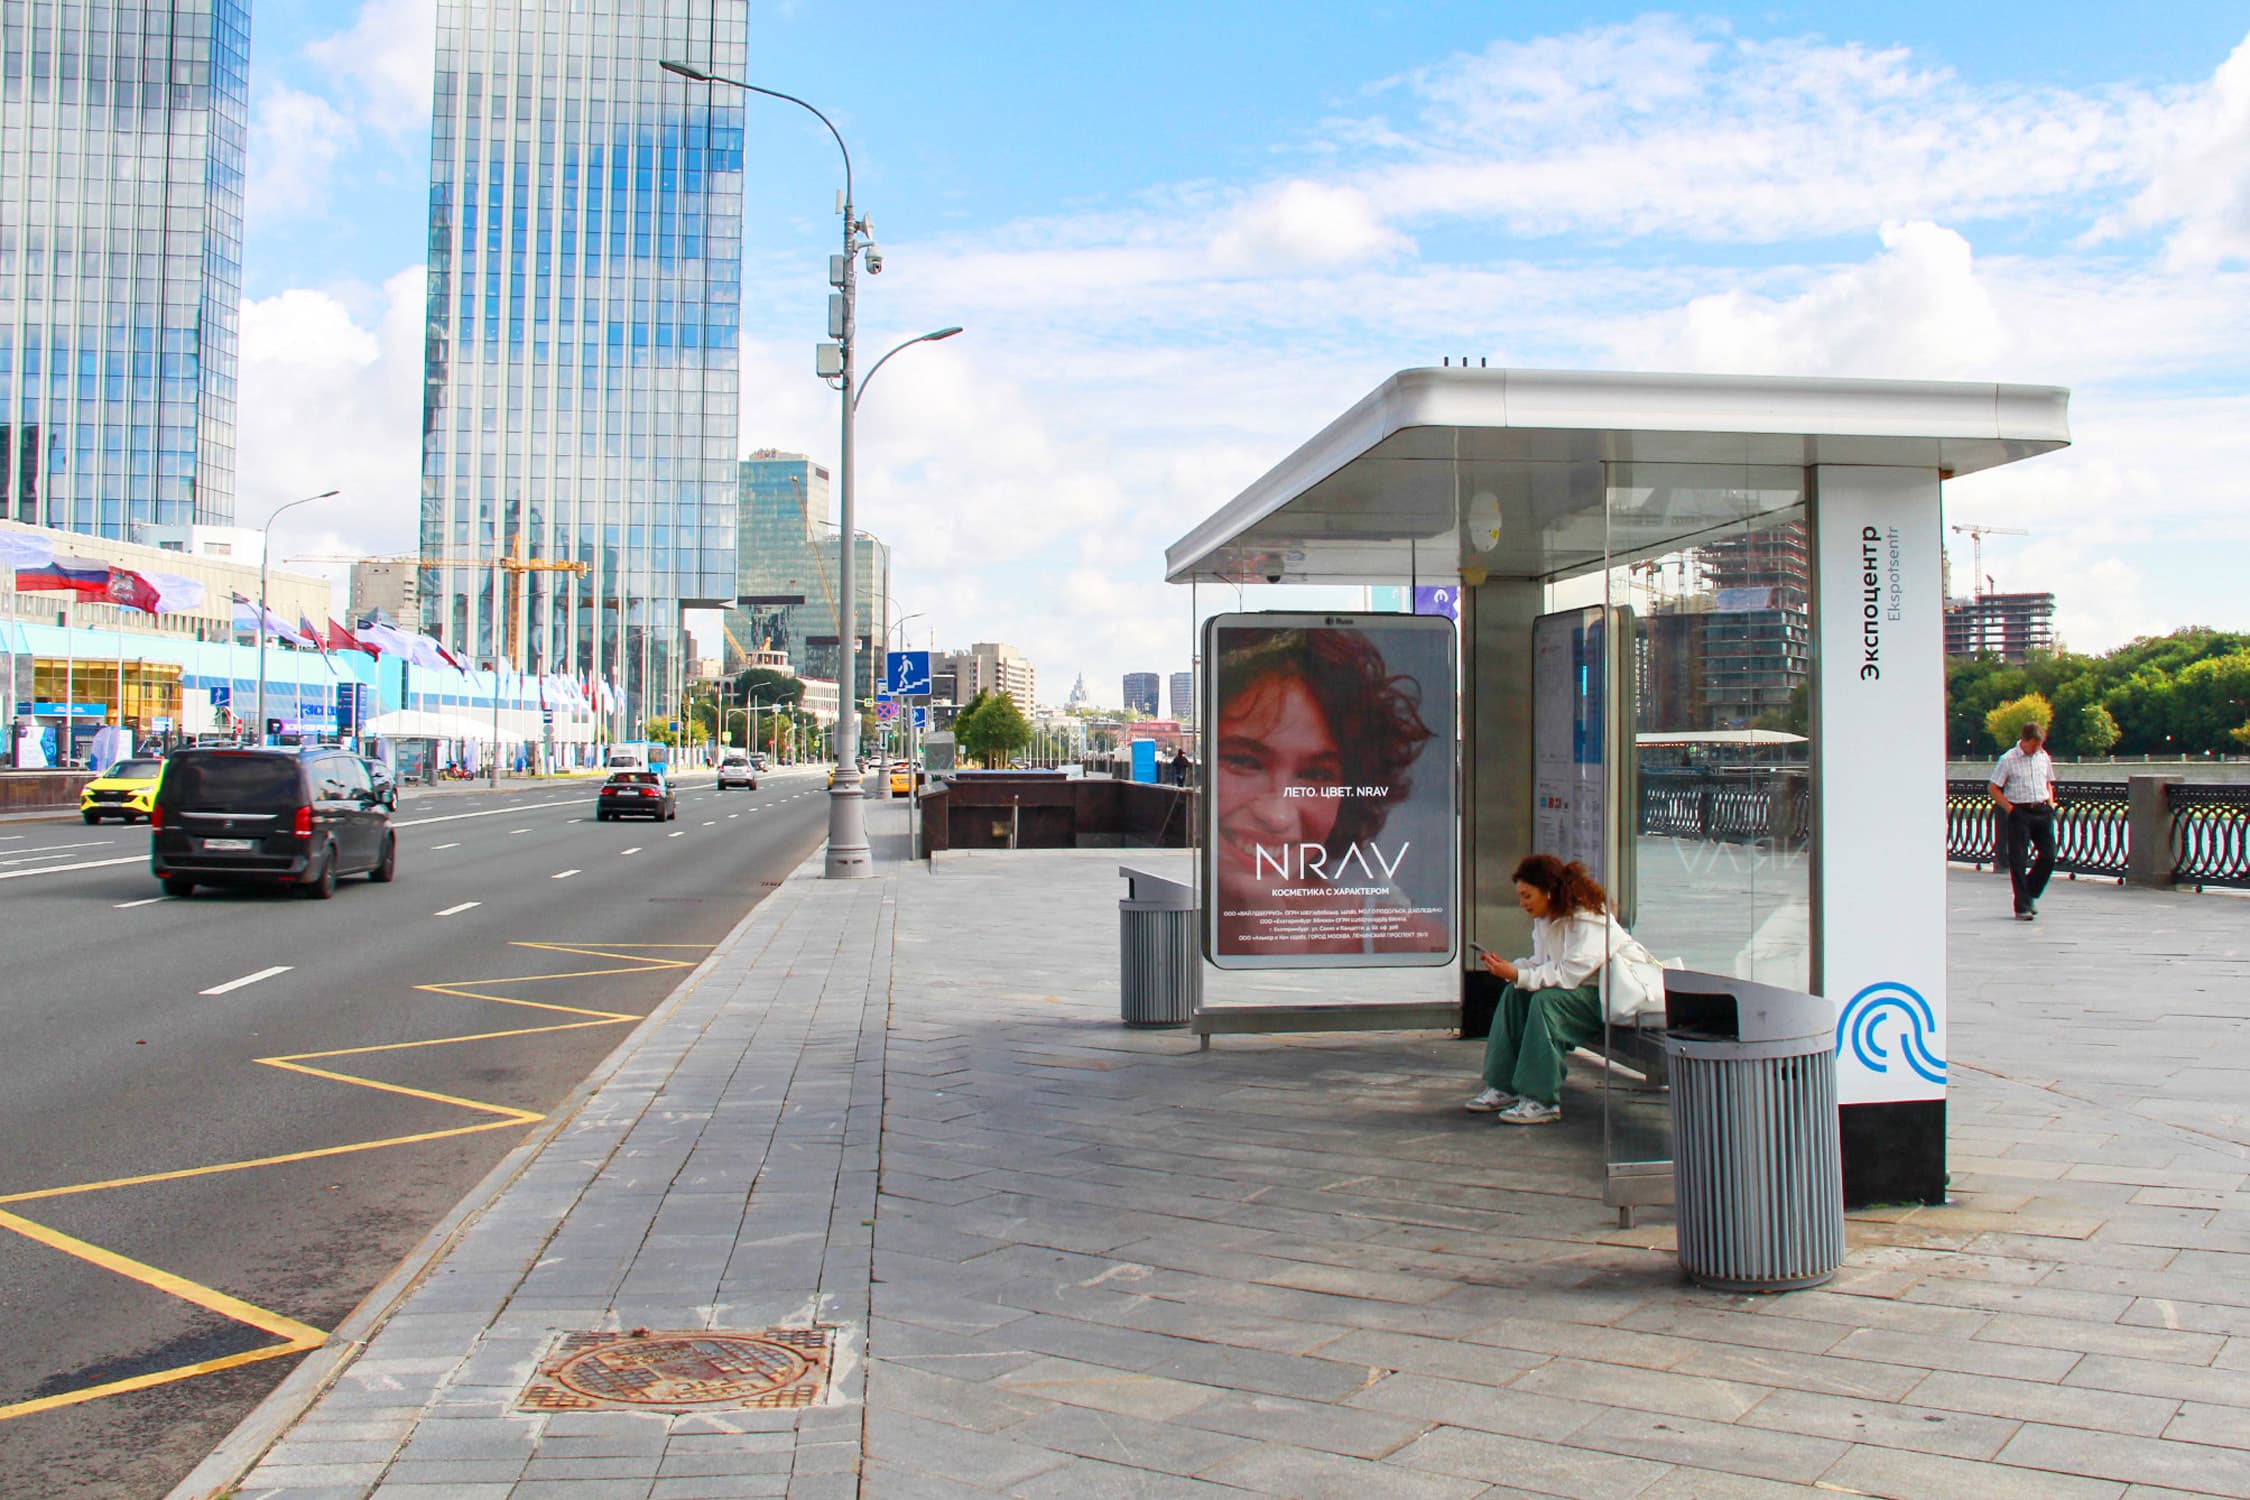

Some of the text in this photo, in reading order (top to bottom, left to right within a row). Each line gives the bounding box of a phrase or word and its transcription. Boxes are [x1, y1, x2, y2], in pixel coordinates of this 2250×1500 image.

[1887, 526, 1903, 621] Ekspotsentr
[1860, 525, 1881, 681] Экспоцентр
[1283, 786, 1389, 798] ЛЕТО. ЦВЕТ. NRAV
[1256, 842, 1410, 881] NRAV
[1272, 887, 1390, 897] КОСМЕТИКА С ХАРАКТЕРОМ
